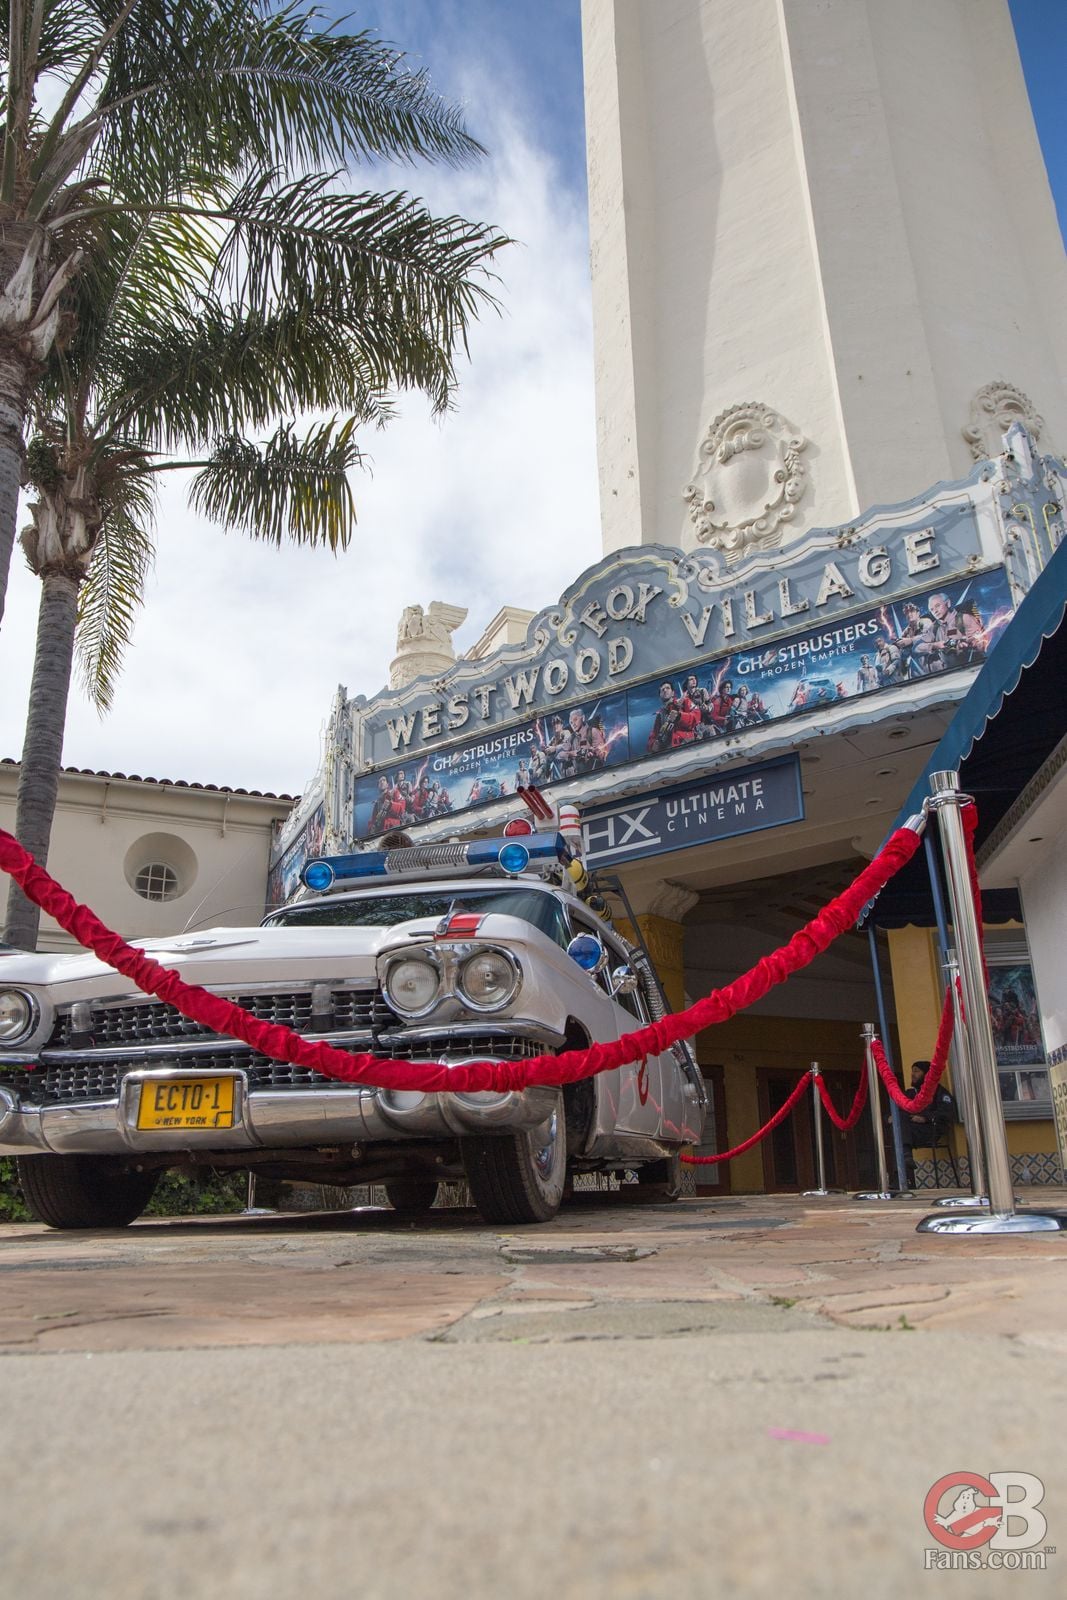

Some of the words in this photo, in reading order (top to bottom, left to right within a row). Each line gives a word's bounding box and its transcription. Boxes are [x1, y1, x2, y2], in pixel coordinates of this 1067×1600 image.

[579, 583, 662, 639] FOX
[386, 636, 634, 751] WESTWOOD
[681, 527, 940, 648] VILLAGE
[761, 660, 805, 679] FROZEN
[811, 643, 855, 663] EMPIRE
[449, 760, 481, 776] FROZEN
[485, 748, 517, 765] EMPIRE
[665, 778, 764, 818] ULTIMATE
[667, 798, 764, 832] CINEMA
[163, 1116, 182, 1126] NEW
[186, 1116, 207, 1125] YORK
